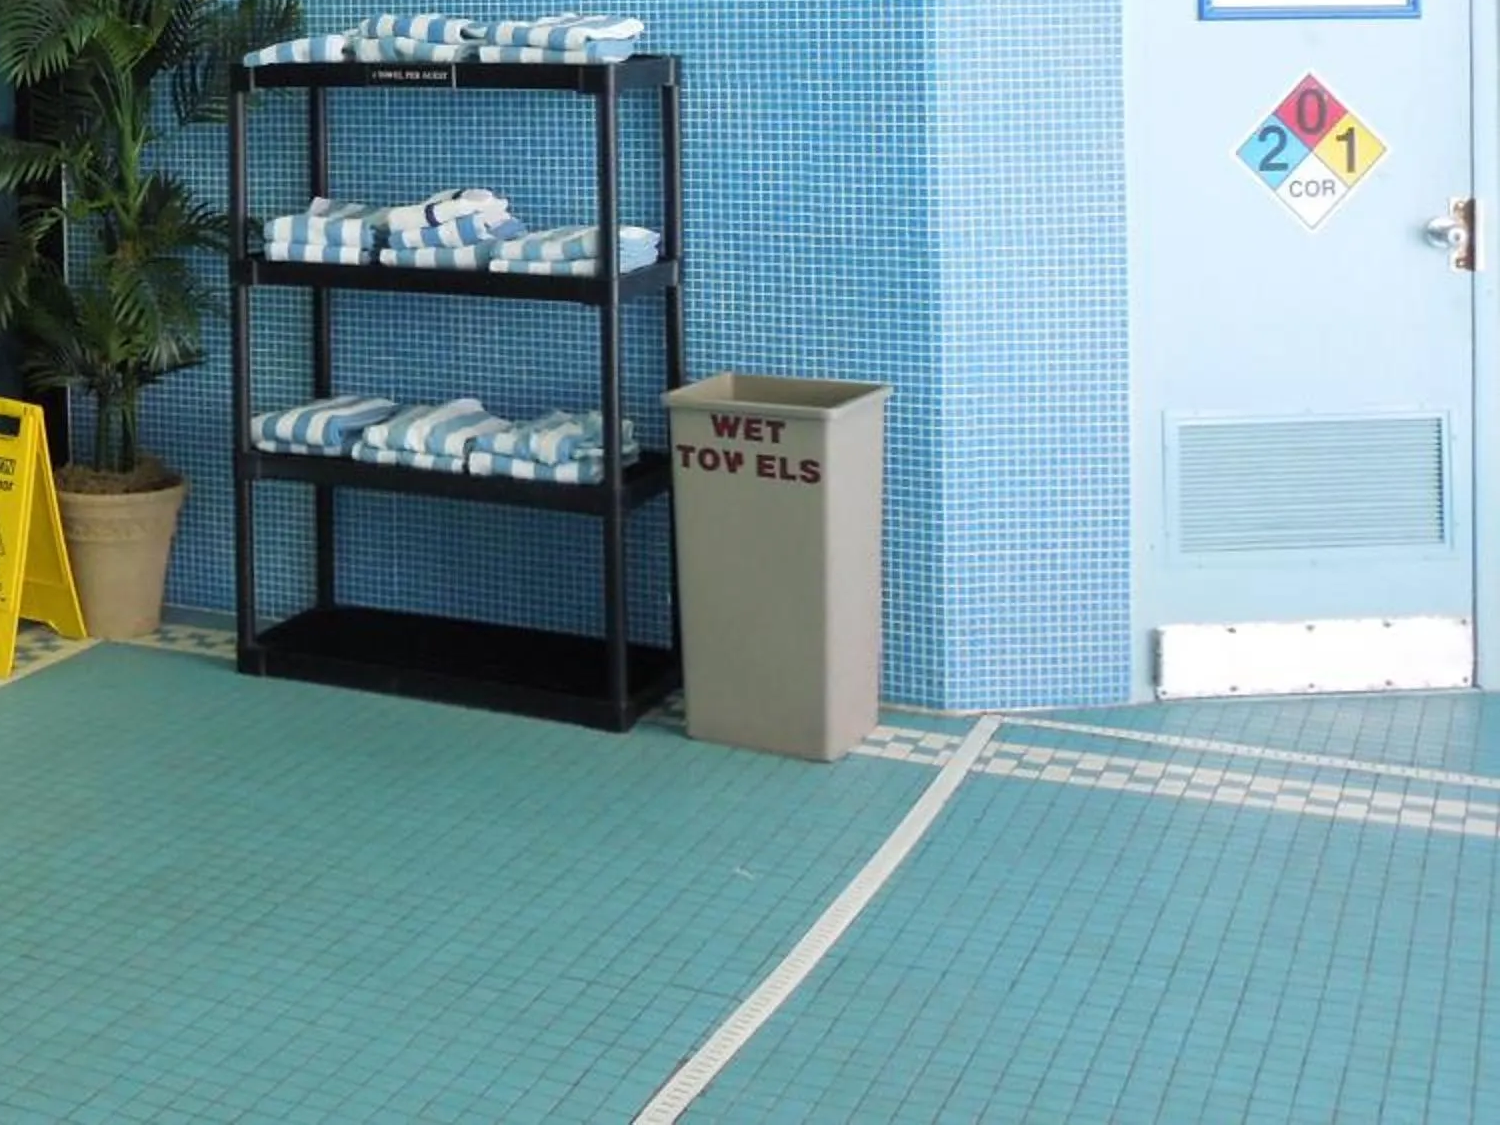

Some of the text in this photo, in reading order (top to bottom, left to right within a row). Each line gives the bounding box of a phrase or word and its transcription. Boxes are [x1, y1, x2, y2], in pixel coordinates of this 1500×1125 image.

[1296, 88, 1328, 136] 0
[1257, 124, 1290, 173] 2
[1335, 125, 1357, 174] 1
[1288, 178, 1337, 199] COR
[710, 413, 786, 444] WET
